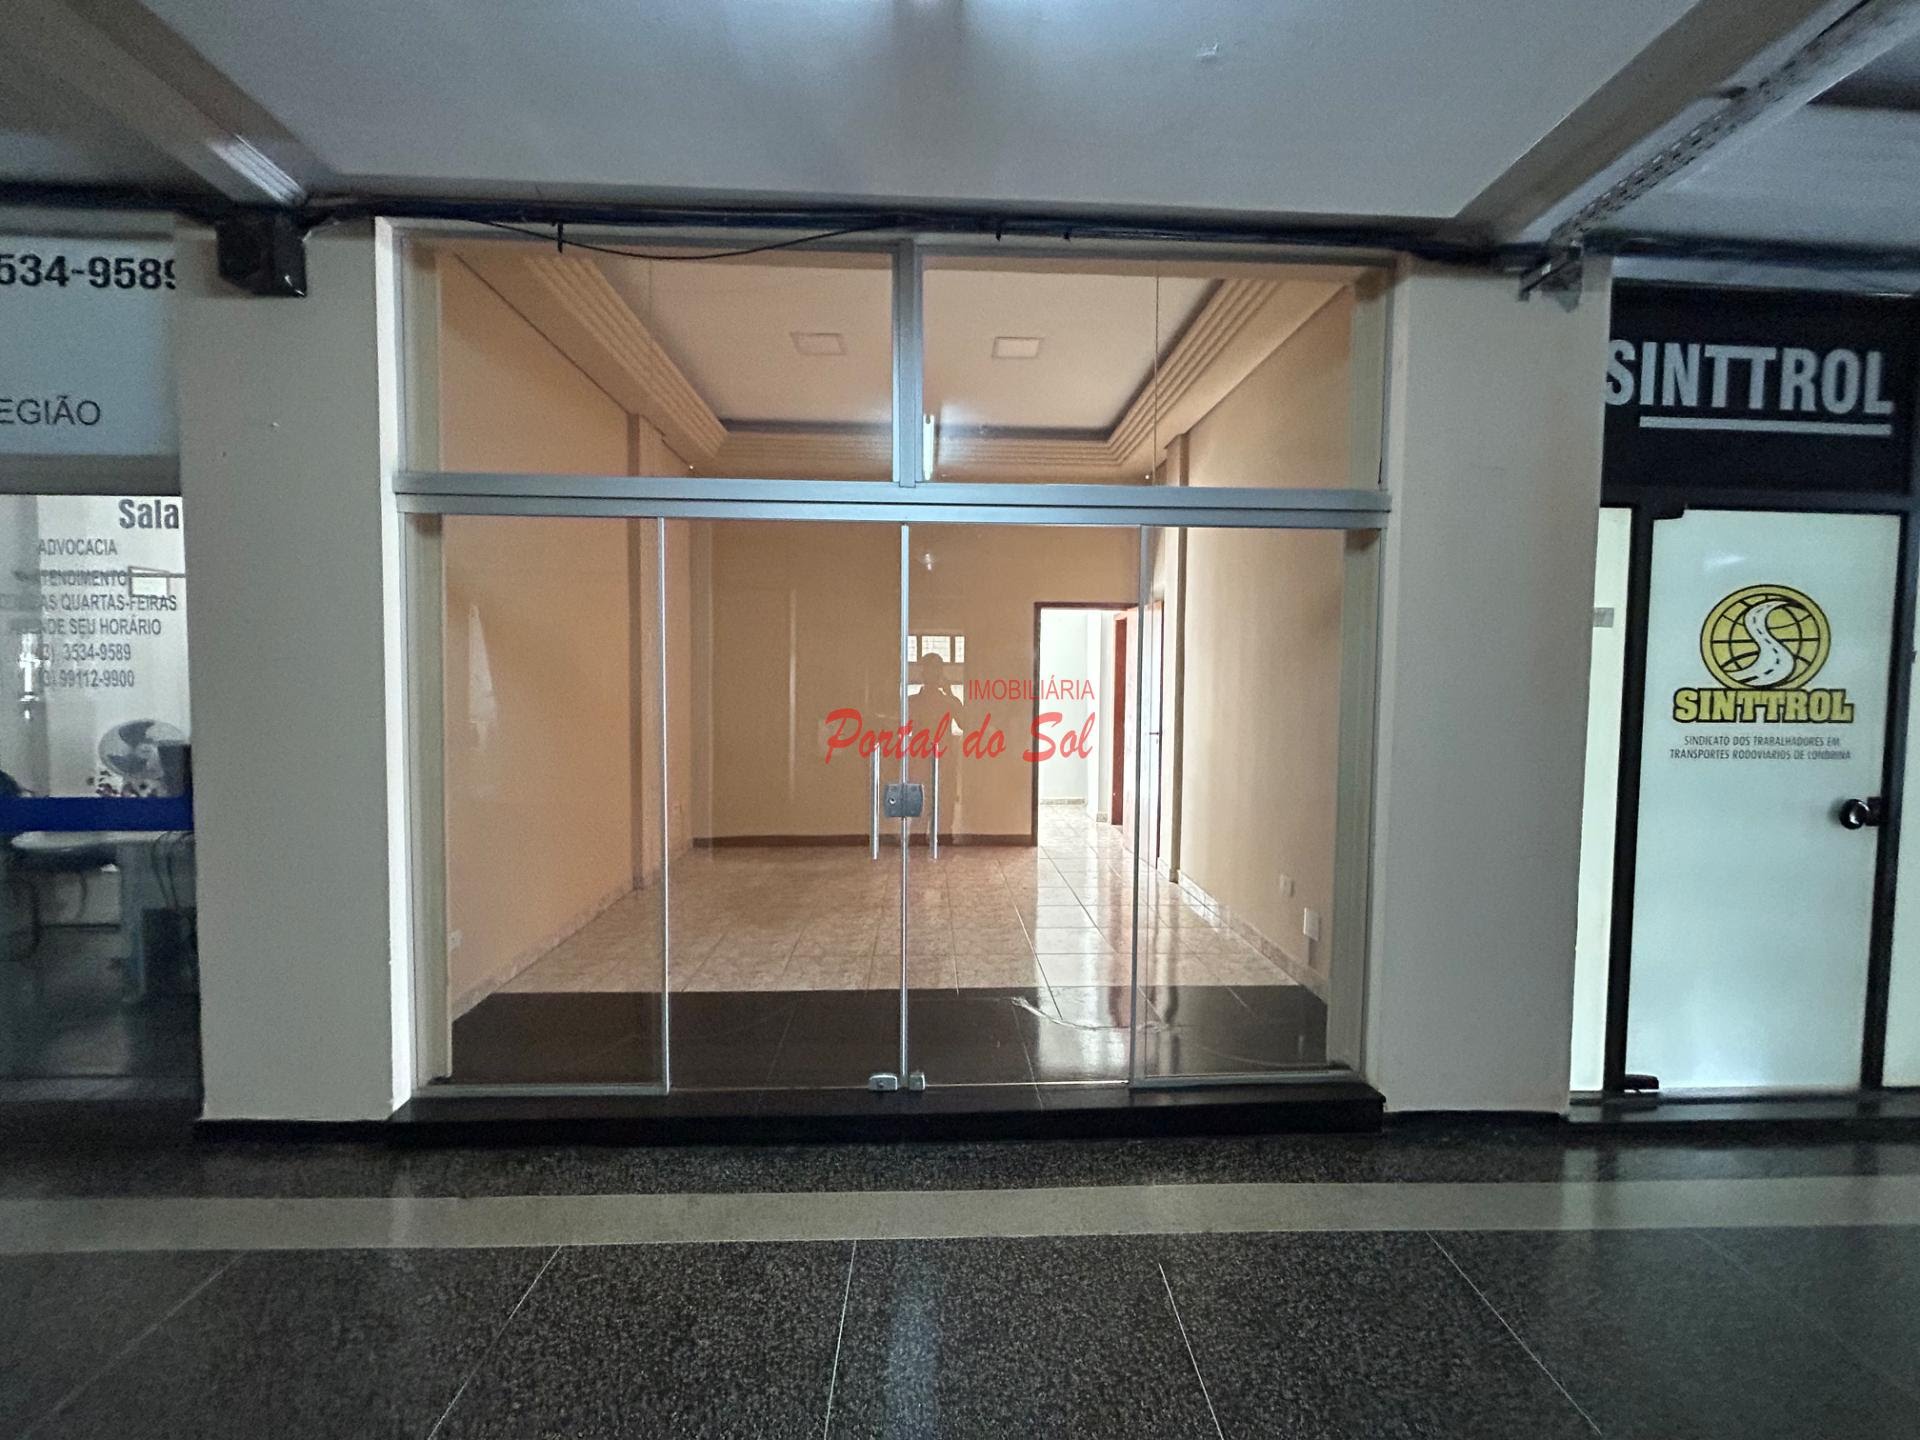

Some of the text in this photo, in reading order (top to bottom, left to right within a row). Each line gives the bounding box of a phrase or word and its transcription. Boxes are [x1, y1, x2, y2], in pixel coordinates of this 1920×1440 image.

[1605, 339, 1894, 415] SINTTROL
[118, 499, 180, 529] Sala
[38, 538, 118, 556] ADVOCACIA
[68, 617, 96, 635] SEU
[99, 614, 162, 635] HORÁRIO
[1673, 687, 1854, 723] SINTTROL
[1684, 735, 1730, 746] SINDICATO
[1733, 736, 1750, 746] DOS
[1669, 749, 1729, 759] TRANSPORTES
[1794, 750, 1804, 760] DE
